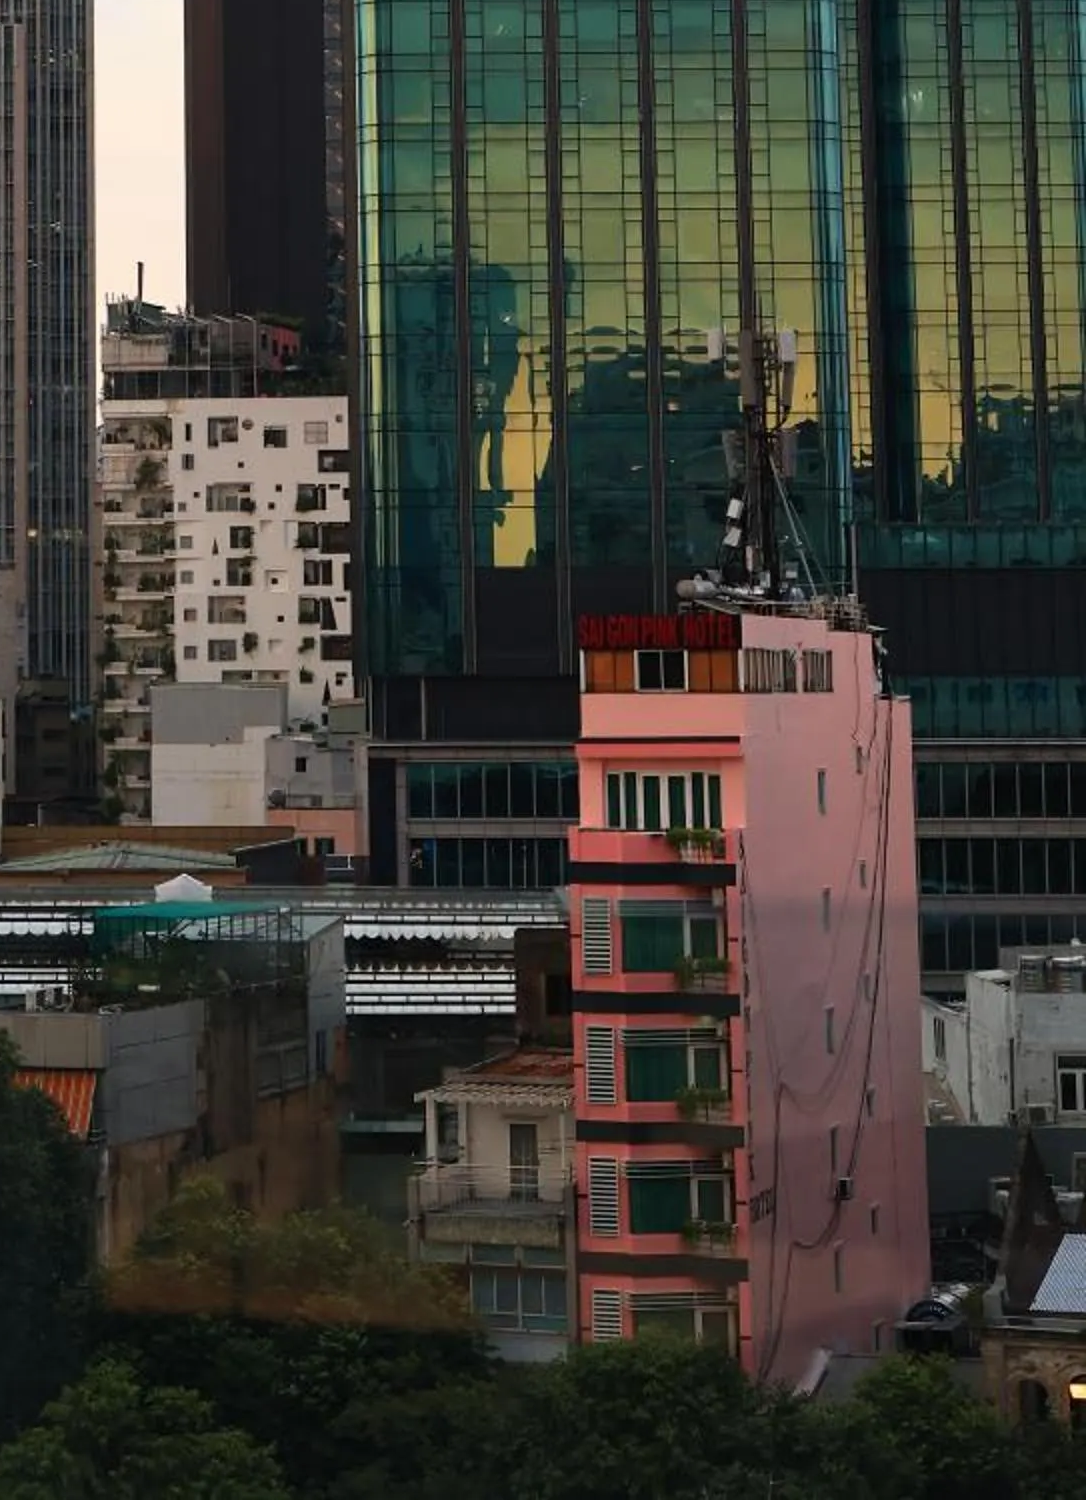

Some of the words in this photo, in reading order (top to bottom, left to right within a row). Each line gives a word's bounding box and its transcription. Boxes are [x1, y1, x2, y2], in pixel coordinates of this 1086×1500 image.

[578, 613, 638, 648] SAIGON
[641, 613, 680, 648] PINK
[685, 613, 737, 648] HOTEL
